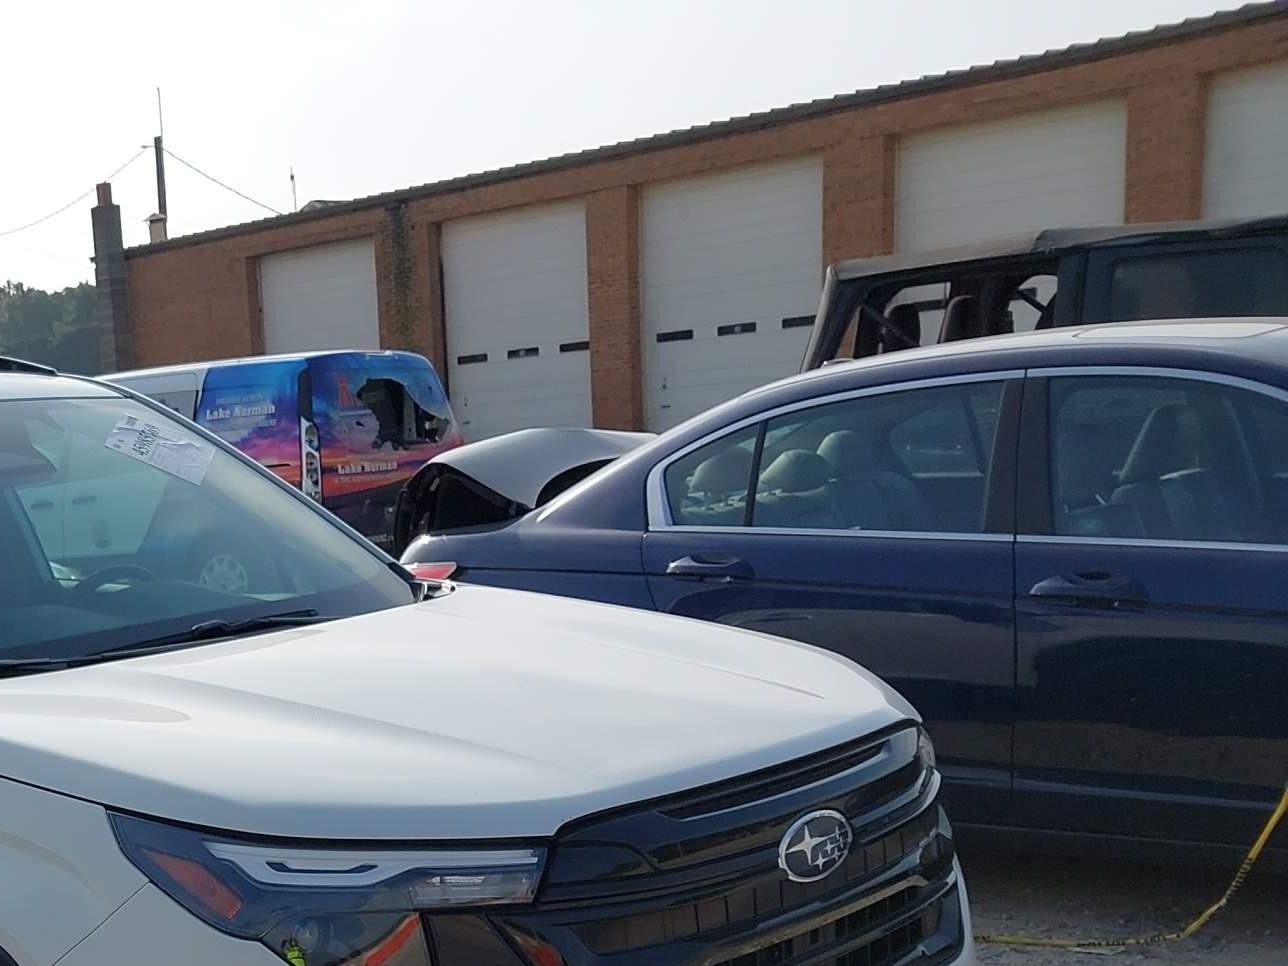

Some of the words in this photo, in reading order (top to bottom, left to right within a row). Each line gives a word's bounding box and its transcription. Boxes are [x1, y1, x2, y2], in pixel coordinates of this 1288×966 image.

[206, 407, 231, 420] Lake
[233, 403, 276, 417] Norman
[337, 463, 362, 474] Lake
